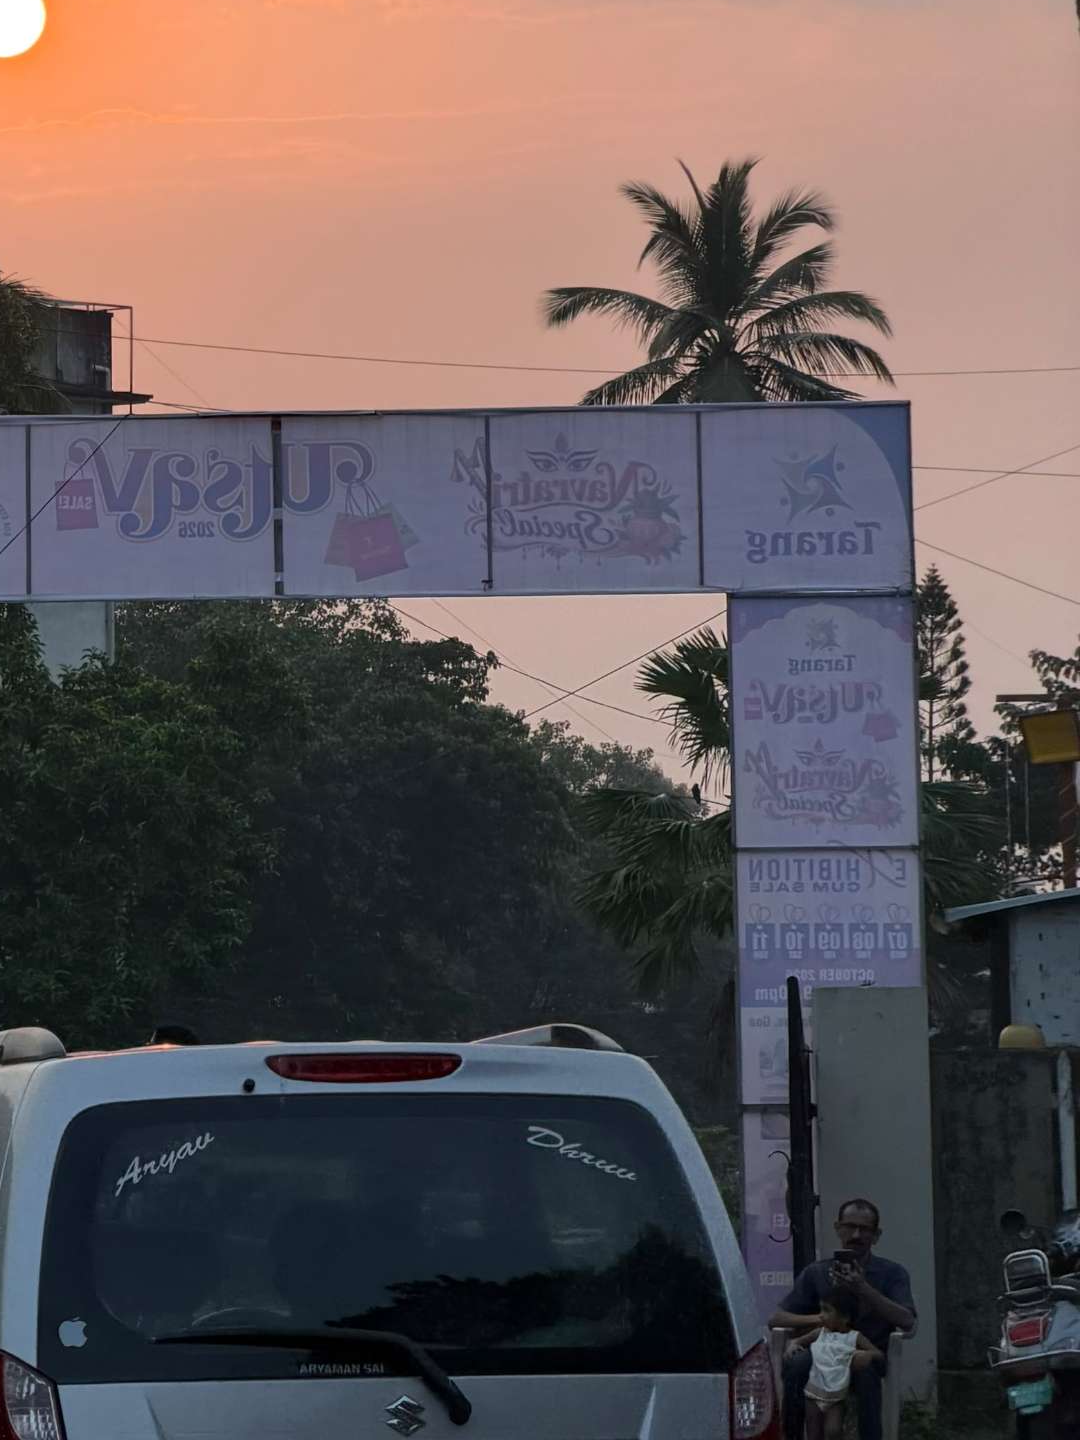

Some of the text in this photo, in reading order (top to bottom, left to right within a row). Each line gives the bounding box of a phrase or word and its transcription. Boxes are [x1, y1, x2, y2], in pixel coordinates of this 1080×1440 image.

[113, 1129, 215, 1198] Aryav
[526, 1124, 640, 1184] Dhruv
[299, 1363, 384, 1374] ARYAMAN SAI
